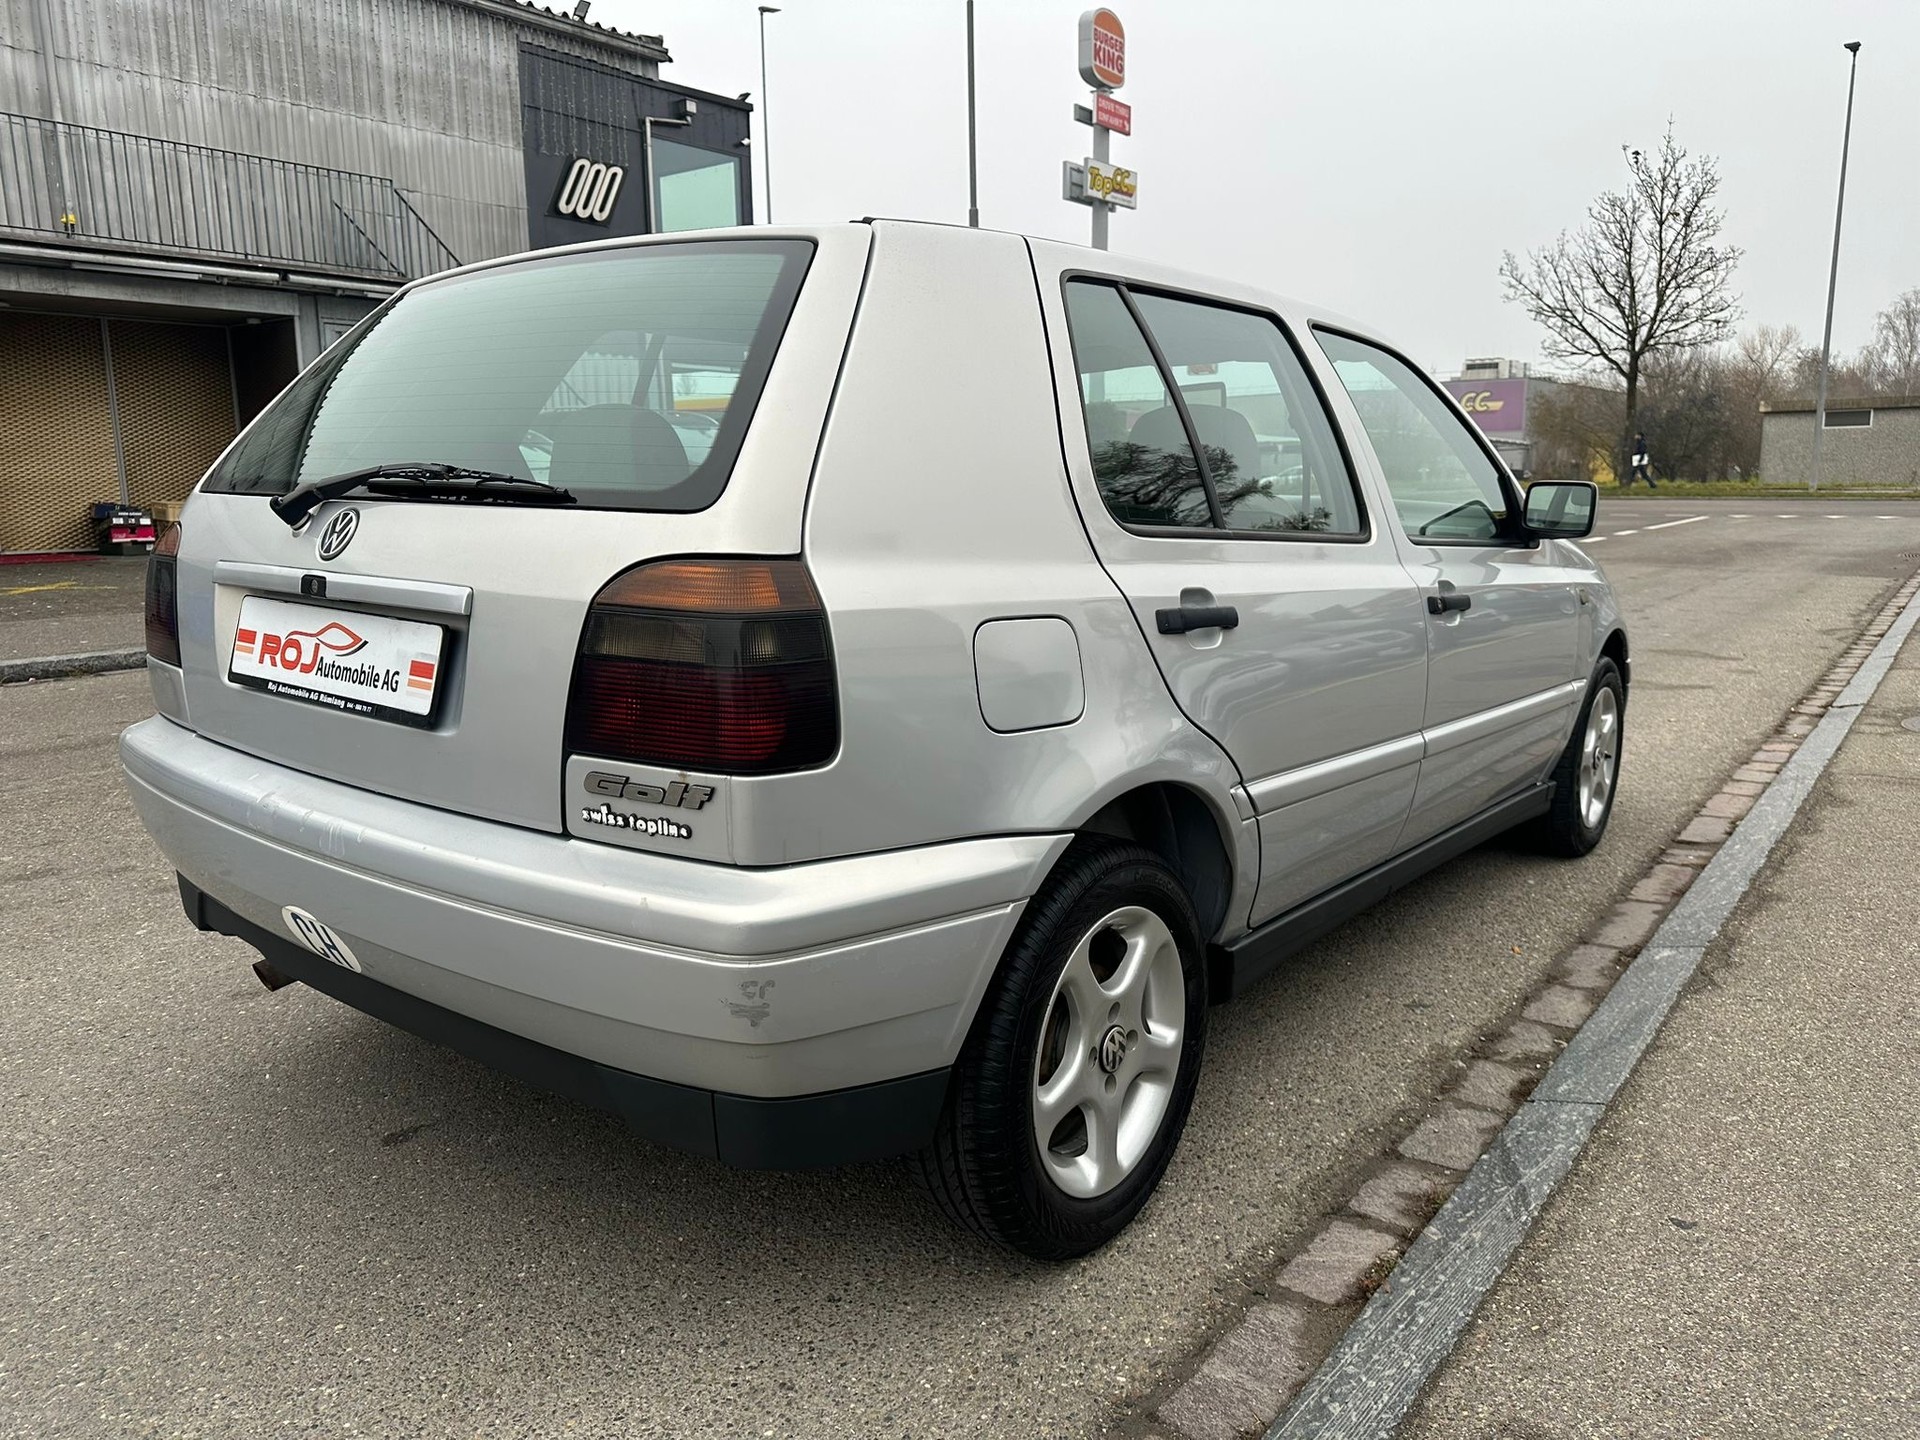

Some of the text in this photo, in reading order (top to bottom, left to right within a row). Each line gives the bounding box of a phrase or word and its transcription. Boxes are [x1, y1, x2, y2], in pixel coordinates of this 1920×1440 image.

[1094, 27, 1124, 54] BURGER
[1094, 42, 1124, 74] KING
[258, 633, 320, 674] ROJ
[268, 681, 277, 692] Roj
[278, 685, 309, 699] Automobile
[309, 691, 319, 700] AG
[315, 656, 400, 692] Automobile AG
[584, 771, 715, 810] Golf
[582, 803, 692, 839] swiss topline
[291, 912, 355, 970] CH
